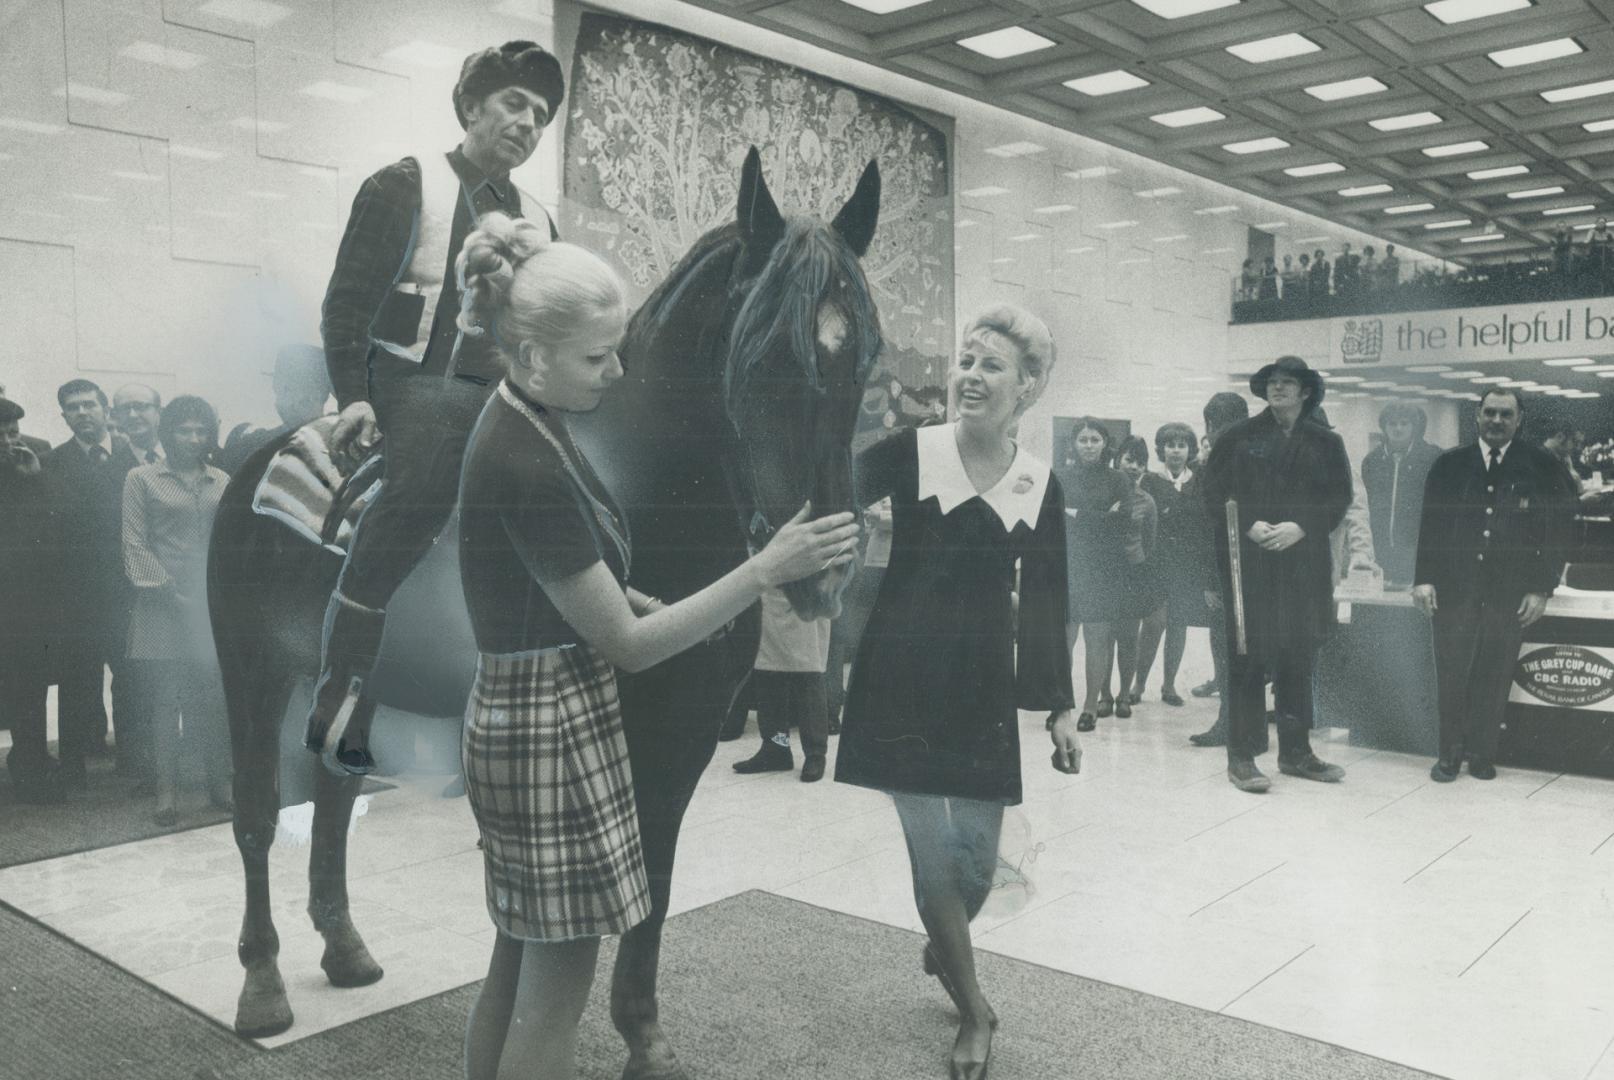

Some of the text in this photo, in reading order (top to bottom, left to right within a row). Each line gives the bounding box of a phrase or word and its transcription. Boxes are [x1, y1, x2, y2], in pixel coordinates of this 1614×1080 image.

[1396, 320, 1447, 350] the
[1458, 308, 1571, 353] helpful
[1522, 658, 1614, 680] THE GREY CUP GAME
[1534, 672, 1601, 686] CBC RADIO
